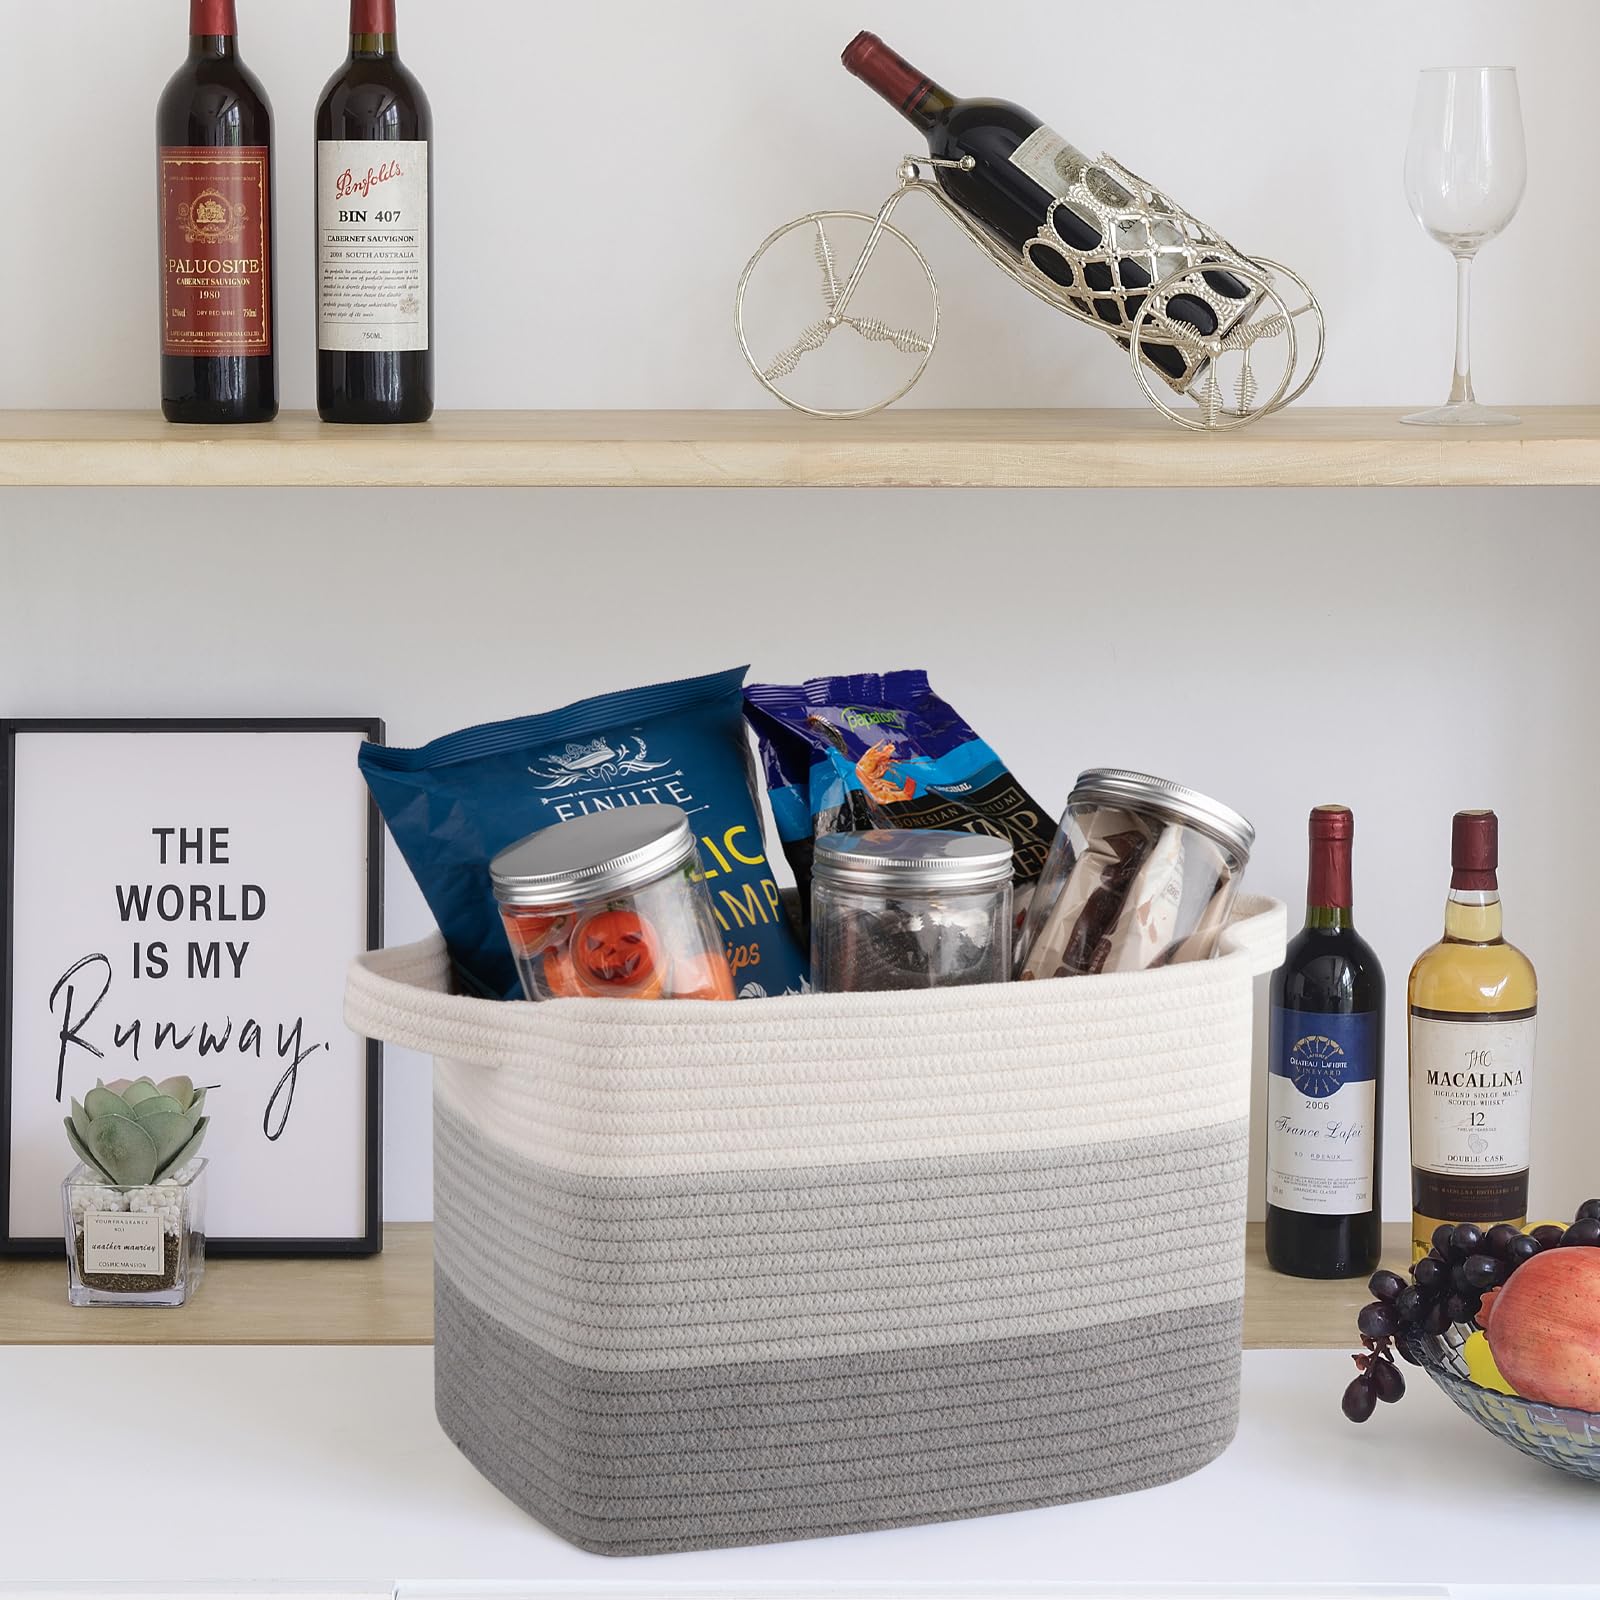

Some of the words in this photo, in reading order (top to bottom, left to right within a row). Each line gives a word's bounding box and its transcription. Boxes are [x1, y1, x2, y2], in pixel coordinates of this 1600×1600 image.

[339, 210, 368, 222] BIN
[375, 210, 401, 222] 407
[327, 235, 366, 243] CABERNET
[367, 235, 414, 243] SAUVIGNON
[169, 259, 260, 274] PALUOSITE
[176, 278, 210, 286] CABERNET
[210, 278, 251, 286] SAUVIGNON
[199, 290, 220, 299] 1980
[152, 827, 230, 865] THE
[115, 884, 266, 922] WORLD
[132, 941, 169, 979] IS
[187, 941, 250, 979] MY
[49, 952, 330, 1141] Runway.
[1296, 1067, 1341, 1075] VINEYARD
[1426, 1069, 1523, 1088] MACALLNA
[1305, 1101, 1330, 1110] 2006
[1274, 1115, 1320, 1137] France
[1471, 1112, 1486, 1126] 12
[1447, 1154, 1481, 1162] DOUBLE
[1484, 1154, 1504, 1162] CASK
